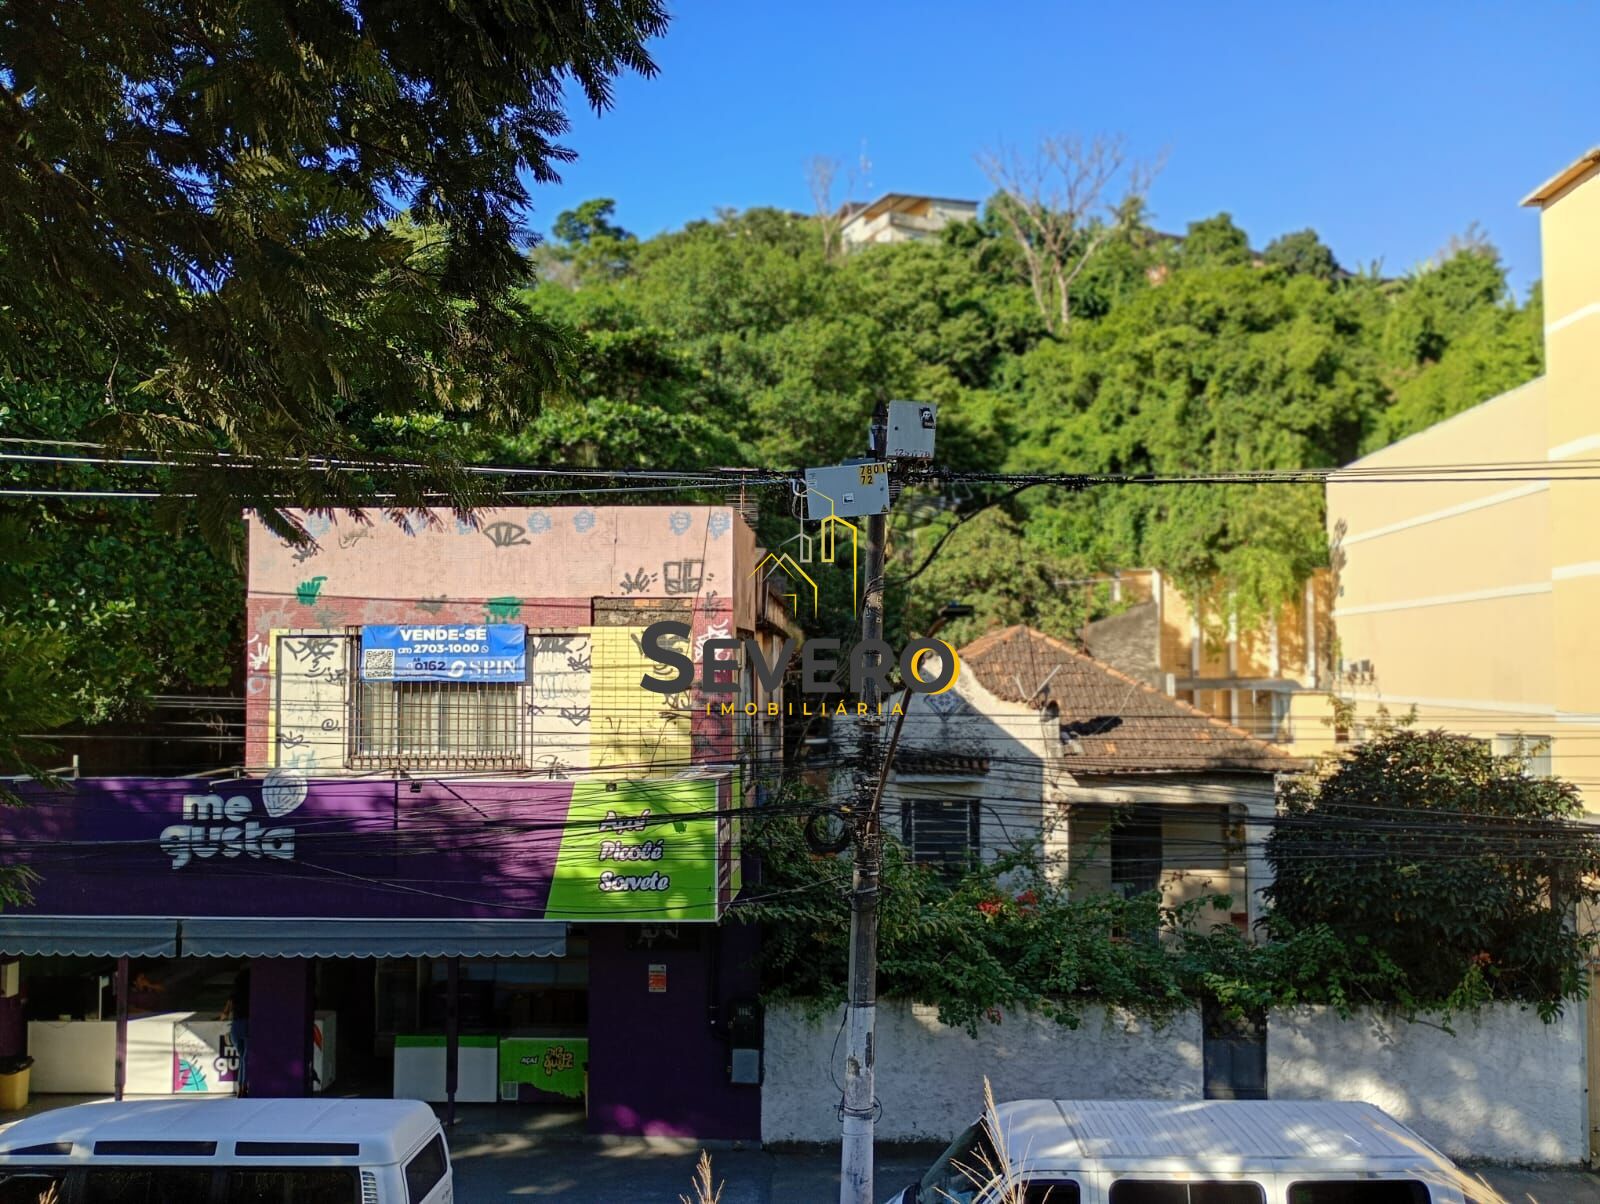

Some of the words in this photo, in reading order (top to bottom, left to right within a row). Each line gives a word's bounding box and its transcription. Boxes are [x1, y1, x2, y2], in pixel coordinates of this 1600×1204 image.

[860, 464, 886, 475] 7801
[861, 475, 874, 485] 72
[400, 628, 487, 642] VENDE-SE
[413, 643, 479, 654] 2703-1000
[469, 660, 516, 675] SPIN
[182, 794, 253, 822] me
[159, 821, 296, 870] gusta
[598, 839, 664, 863] Picolé
[599, 870, 671, 893] Sorvete
